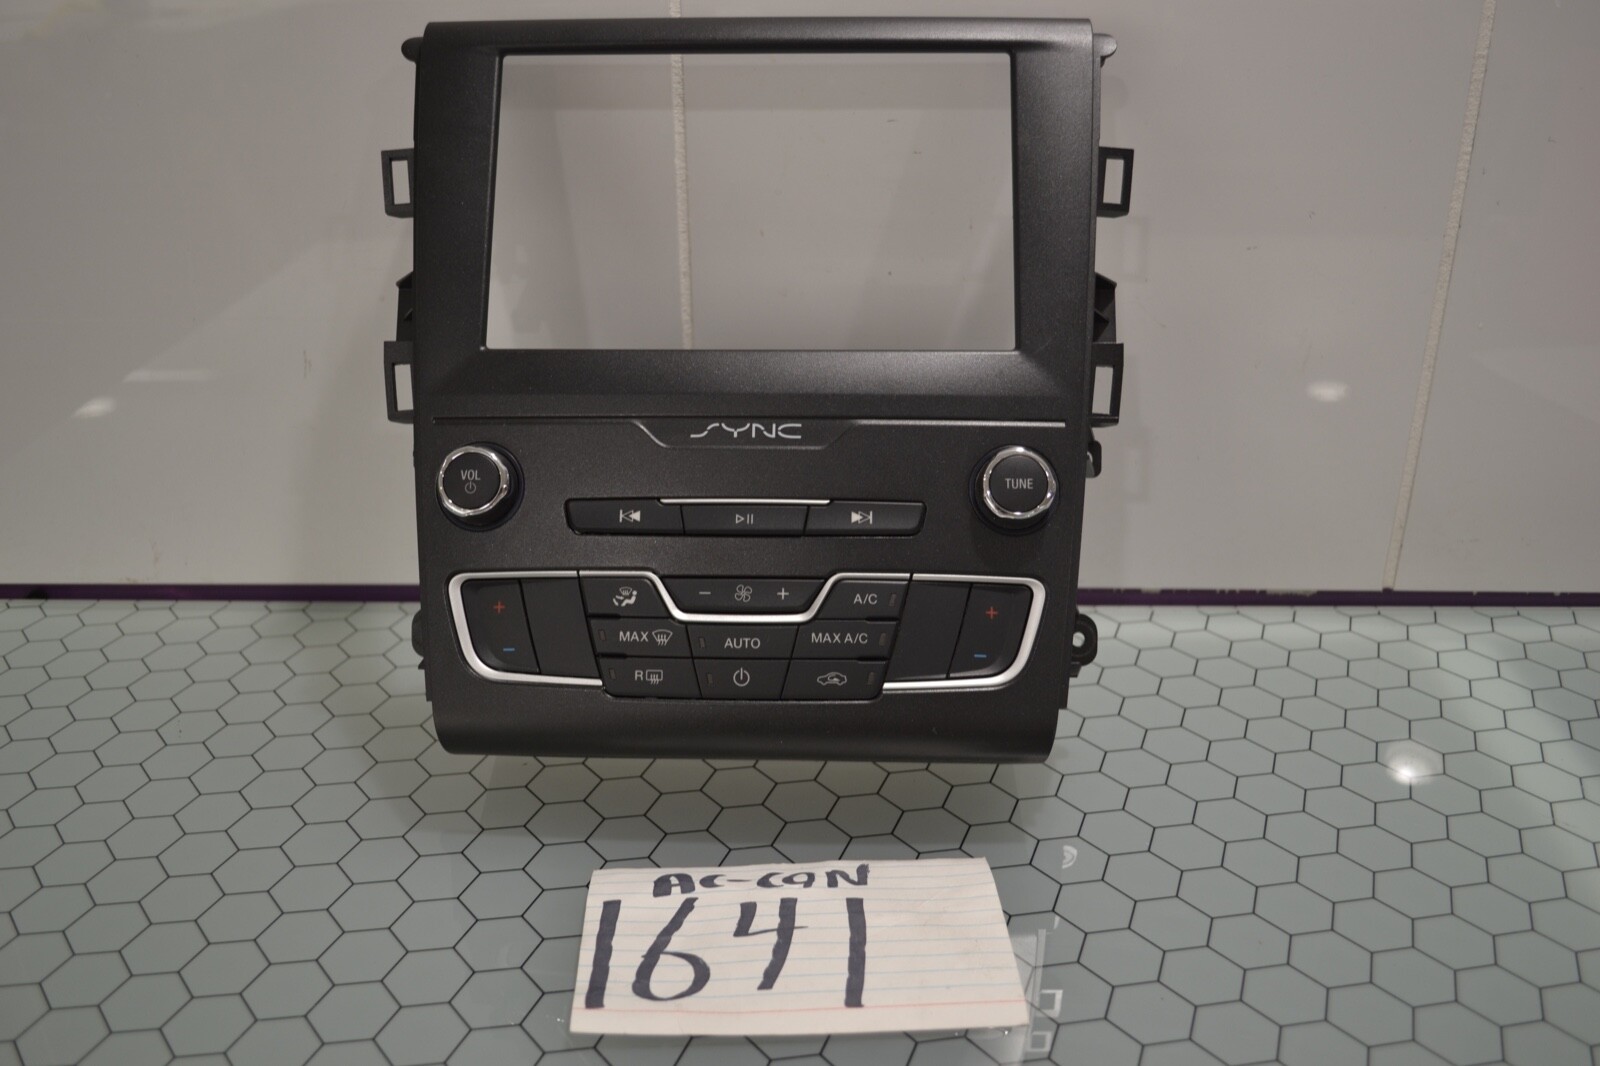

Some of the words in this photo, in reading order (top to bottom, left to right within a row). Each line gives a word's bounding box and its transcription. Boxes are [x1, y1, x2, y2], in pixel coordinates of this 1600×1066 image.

[690, 422, 803, 438] SYNC
[460, 469, 481, 481] VOL
[1005, 477, 1034, 490] TUNE
[853, 594, 878, 605] A/C
[619, 631, 649, 642] MAX
[811, 632, 841, 644] MAX
[843, 632, 869, 644] A/C
[724, 637, 761, 650] AUTO
[634, 670, 643, 681] R
[585, 897, 867, 1008] 1641
